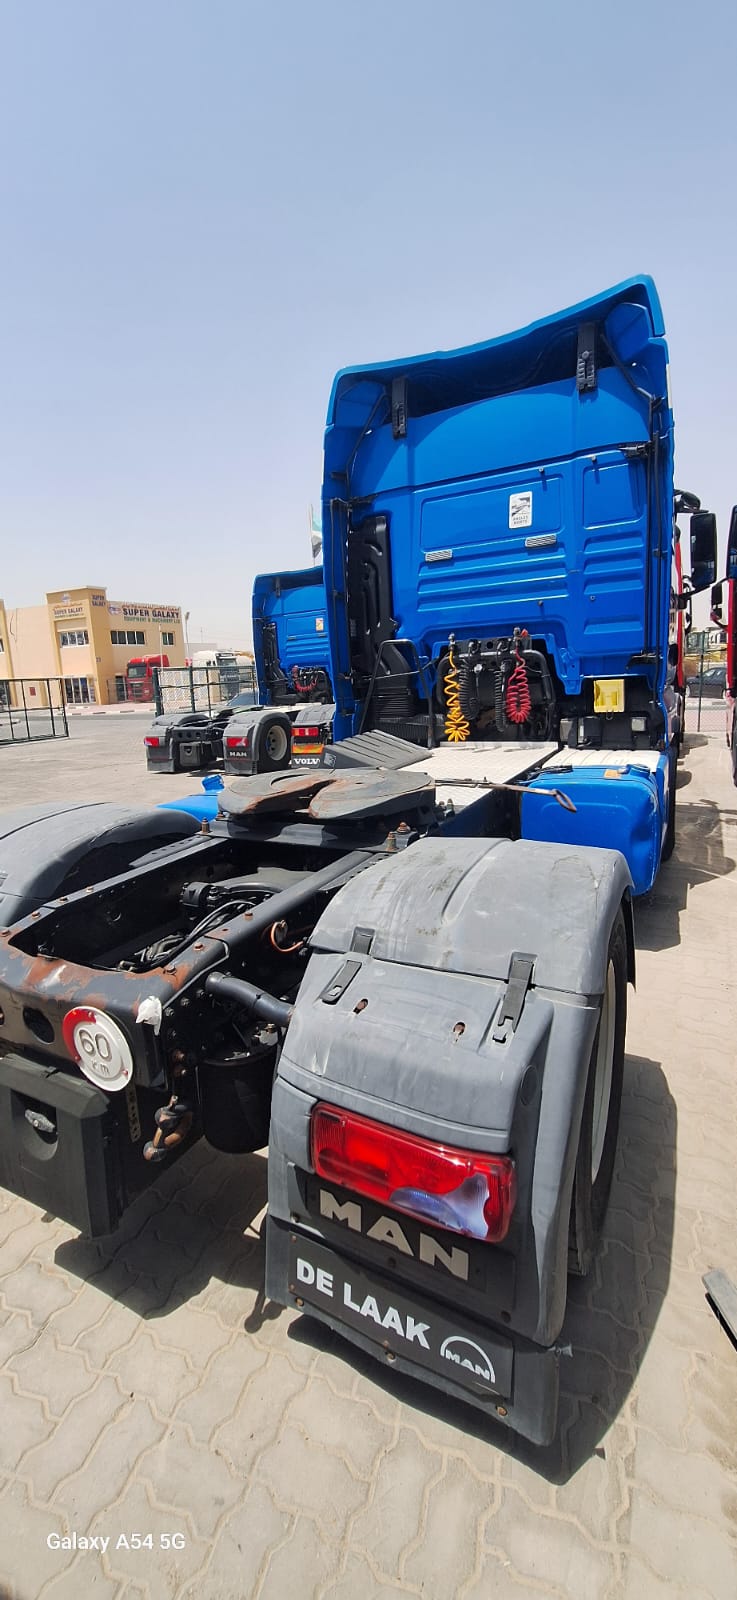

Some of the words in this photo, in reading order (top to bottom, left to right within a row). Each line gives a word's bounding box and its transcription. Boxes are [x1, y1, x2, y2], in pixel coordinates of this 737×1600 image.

[123, 608, 150, 616] SUPER
[152, 609, 179, 618] GALAXY
[79, 1029, 112, 1062] 60
[319, 1189, 469, 1281] MAN
[296, 1258, 334, 1298] DE
[343, 1282, 431, 1350] LAAK
[445, 1349, 490, 1380] MAN
